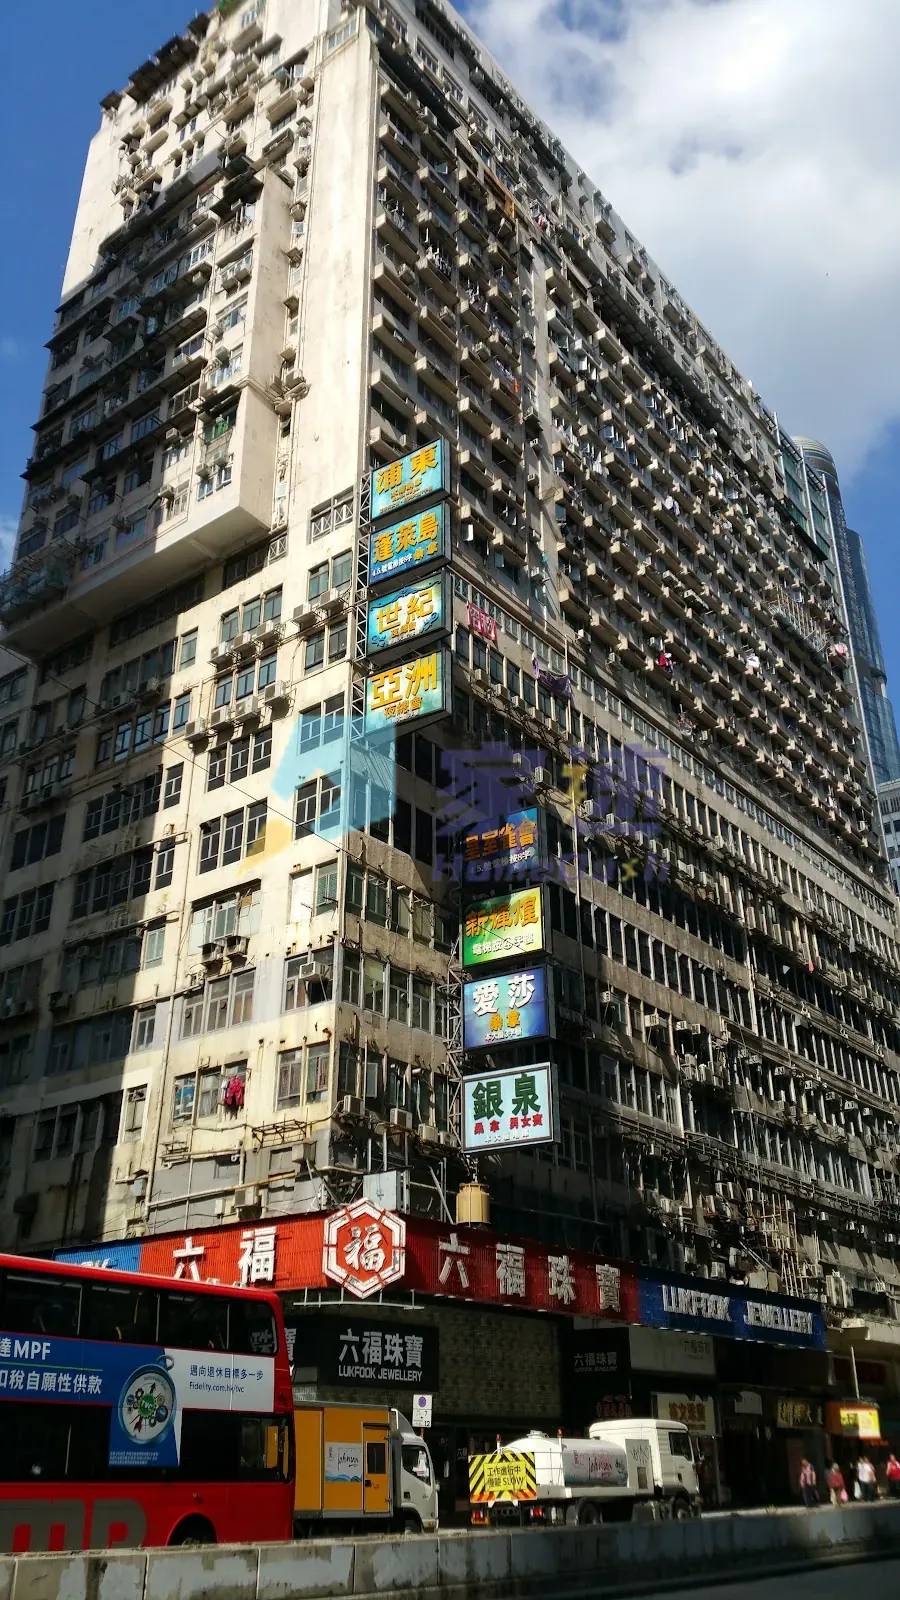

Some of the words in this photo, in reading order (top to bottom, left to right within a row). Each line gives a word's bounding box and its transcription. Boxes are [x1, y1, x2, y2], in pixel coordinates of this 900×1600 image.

[375, 444, 439, 494] 浦東
[373, 513, 439, 563] 蓬萊島
[376, 588, 434, 634] 世紀
[371, 653, 438, 710] 亞洲
[384, 697, 422, 718] 夜總會
[465, 896, 539, 938] 新輝煌
[473, 974, 535, 1017] 愛莎
[472, 1073, 541, 1121] 銀泉
[172, 1226, 277, 1287] 六福
[343, 1222, 387, 1273] 福
[438, 1233, 621, 1312] 六福珠寶
[662, 1285, 731, 1322] LUKFOOK
[743, 1300, 814, 1335] JEWELLERY
[338, 1328, 424, 1368] 六福珠寶
[574, 1351, 618, 1366] 六福珠寶
[189, 1364, 264, 1381] 邁向退休目標多一步
[338, 1365, 376, 1379] LUKFOOK
[378, 1368, 423, 1382] JEWELLERY
[502, 1475, 524, 1486] SLOW
